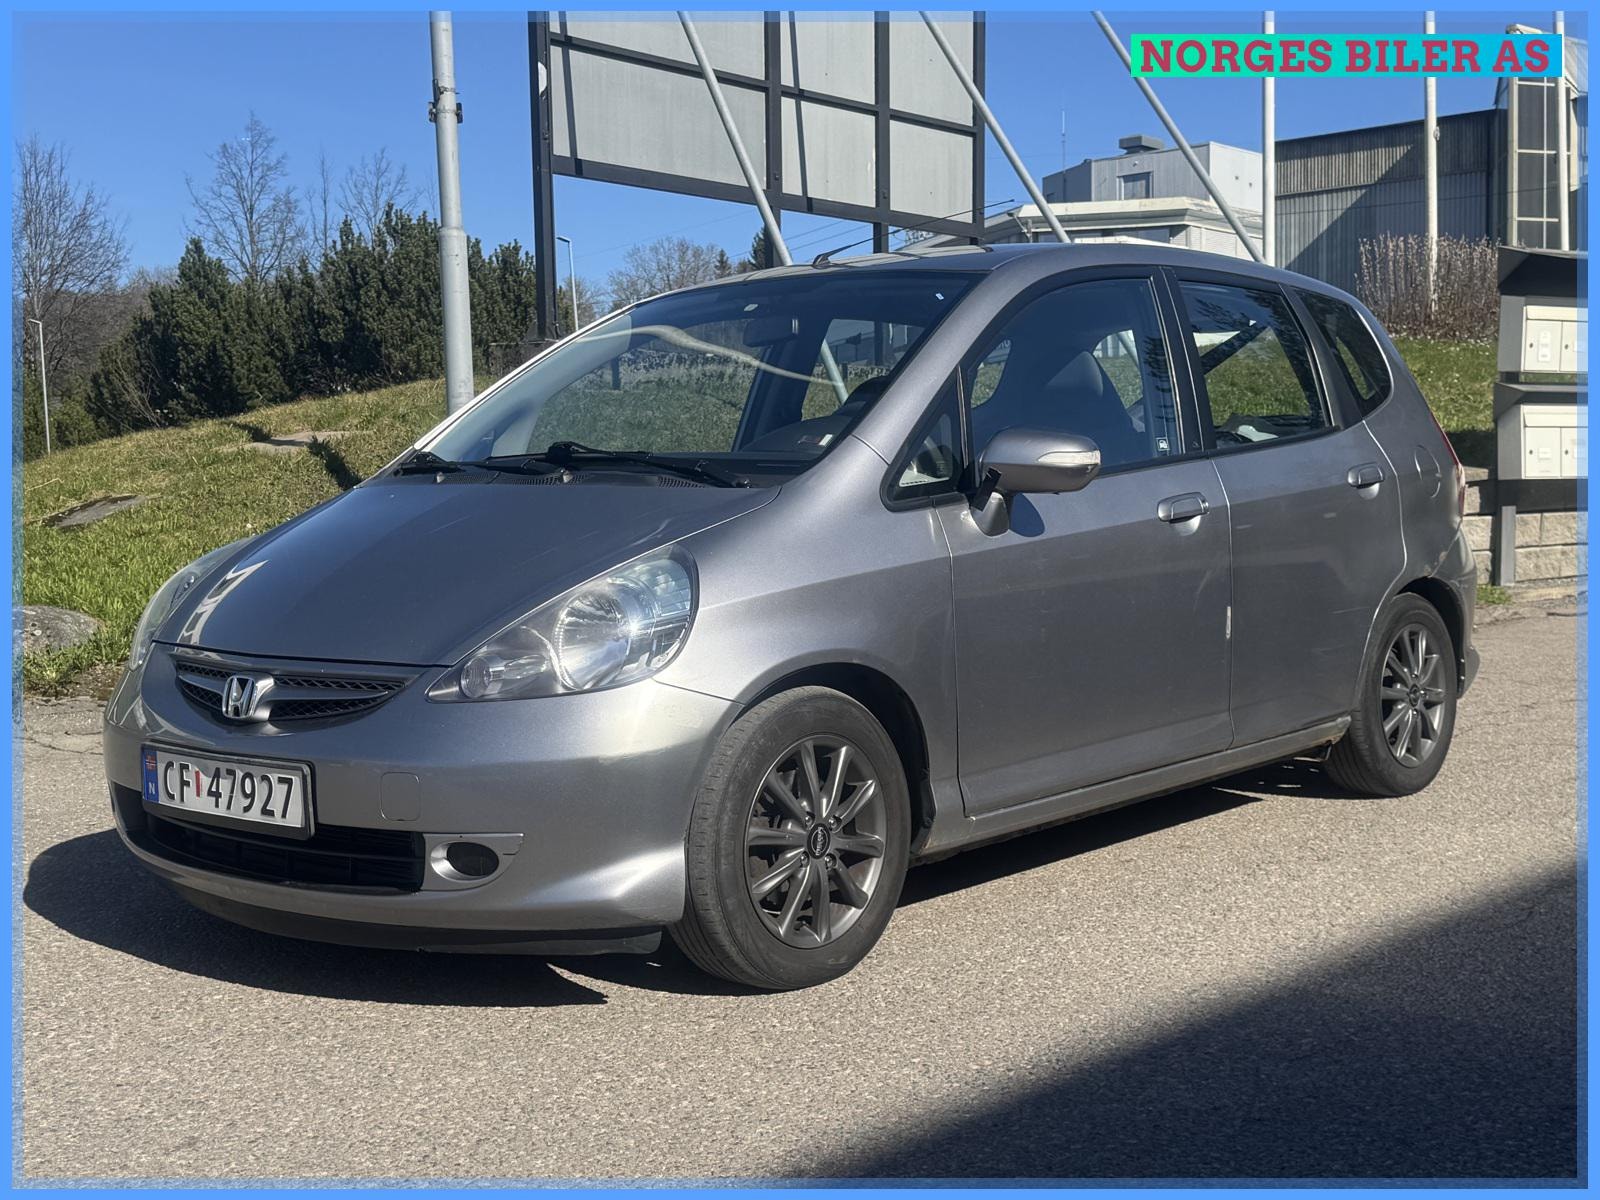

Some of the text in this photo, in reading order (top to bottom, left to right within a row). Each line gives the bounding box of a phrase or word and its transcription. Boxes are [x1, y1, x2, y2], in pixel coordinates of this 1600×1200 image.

[148, 782, 156, 795] N
[163, 761, 293, 819] CF 47927
